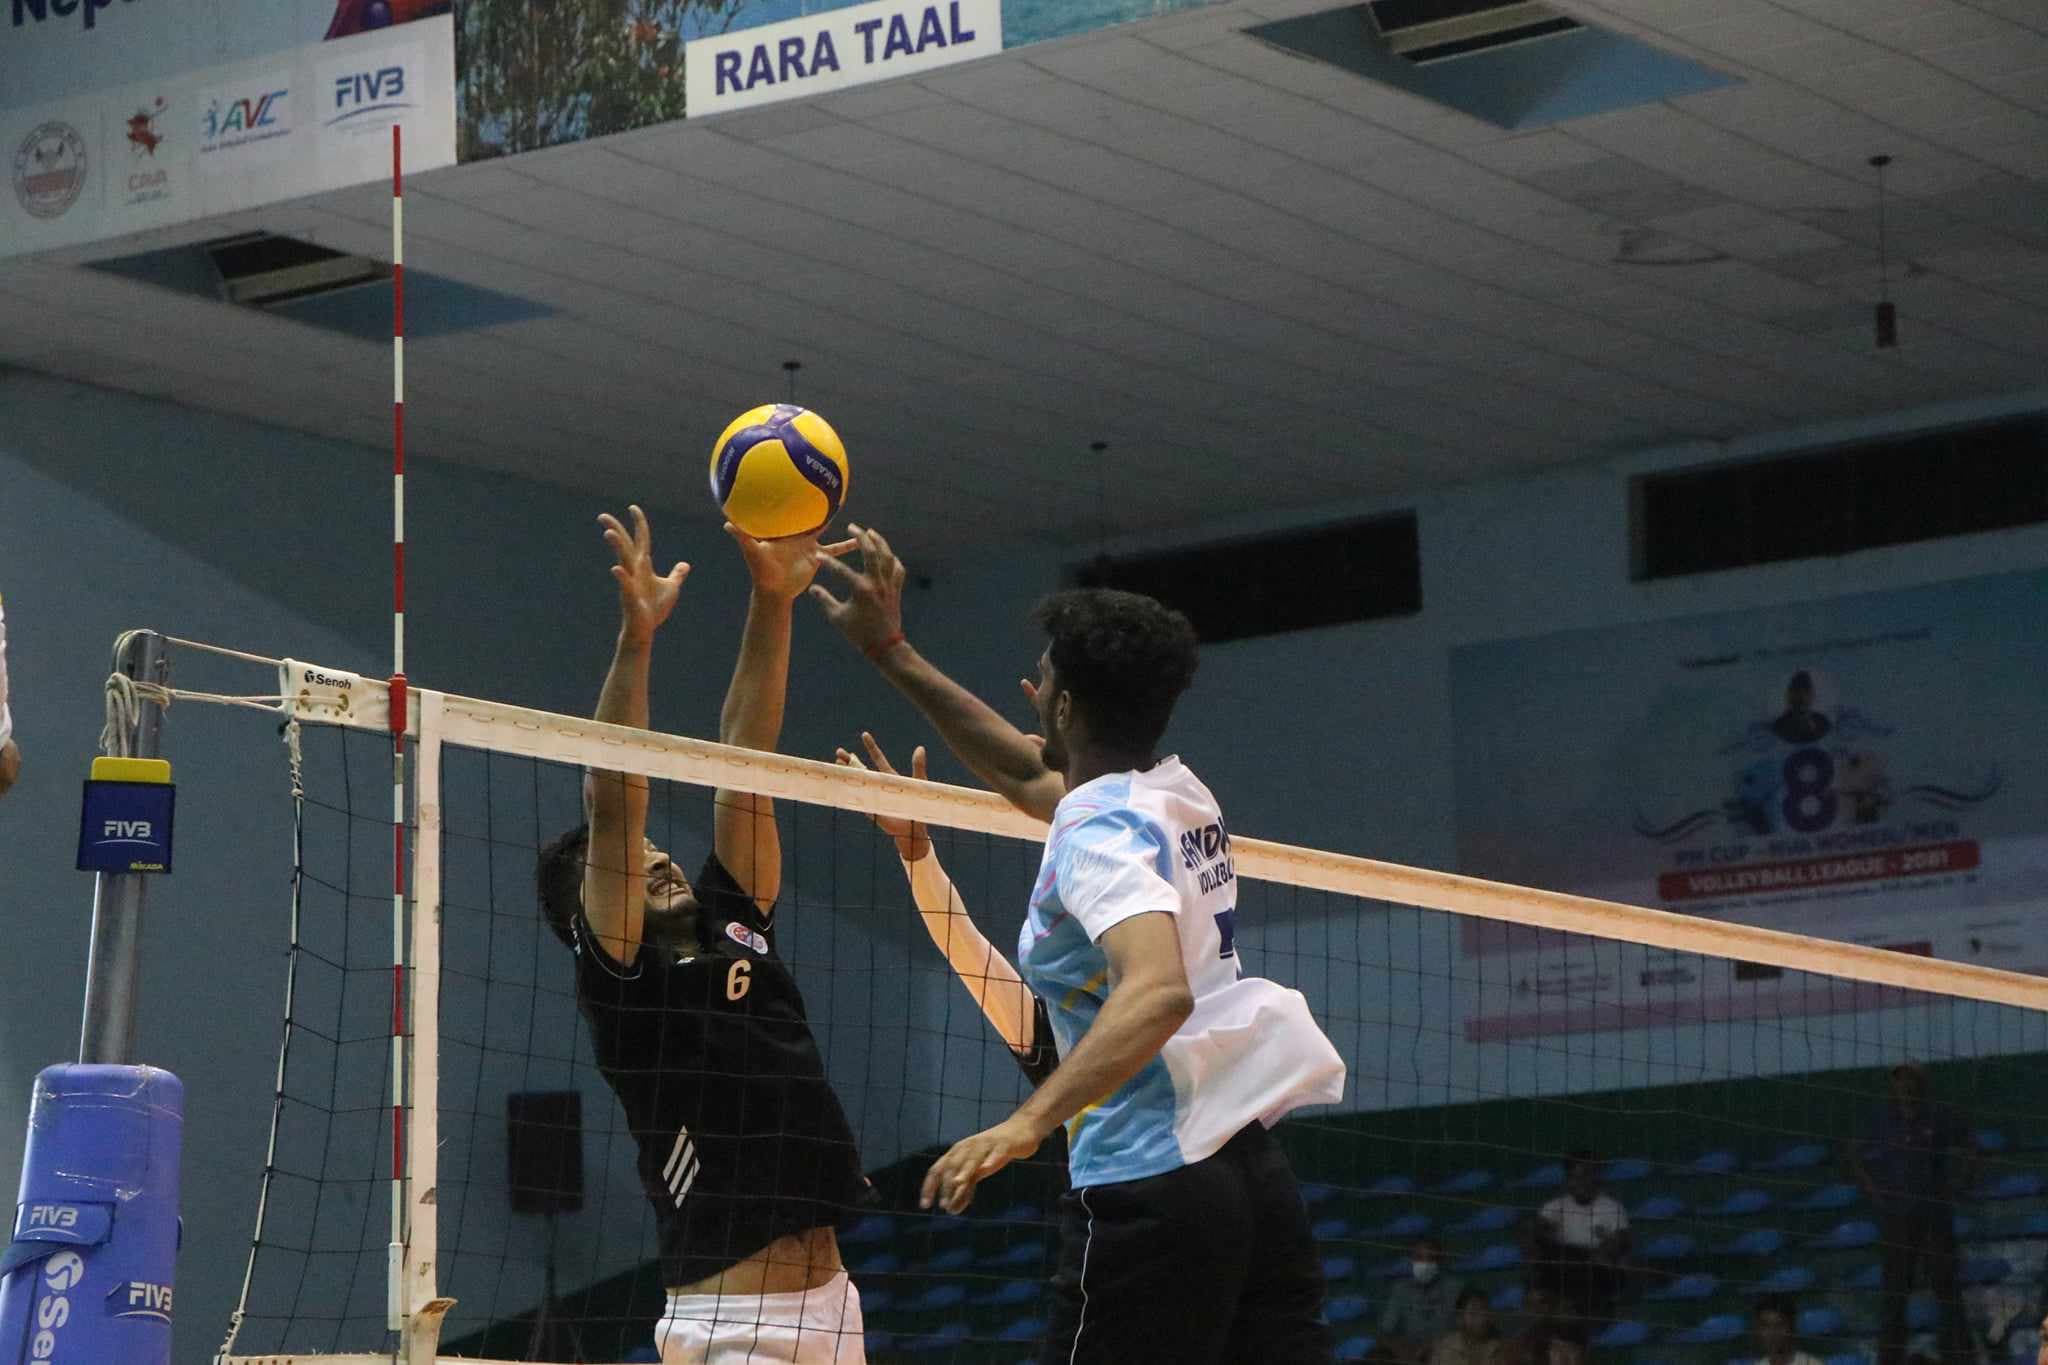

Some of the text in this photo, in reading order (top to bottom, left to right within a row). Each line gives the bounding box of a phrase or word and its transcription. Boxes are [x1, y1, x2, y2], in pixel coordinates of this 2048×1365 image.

[715, 0, 976, 96] RARA TAAL
[335, 66, 404, 107] FIVB
[315, 673, 352, 690] Senoh
[104, 820, 152, 838] FIVB
[1688, 862, 1804, 893] VOLLEYBALL
[1810, 856, 1884, 881] LEAGUE
[726, 959, 751, 1001] 6
[30, 1205, 80, 1226] FIVB
[129, 1280, 173, 1312] FIVB
